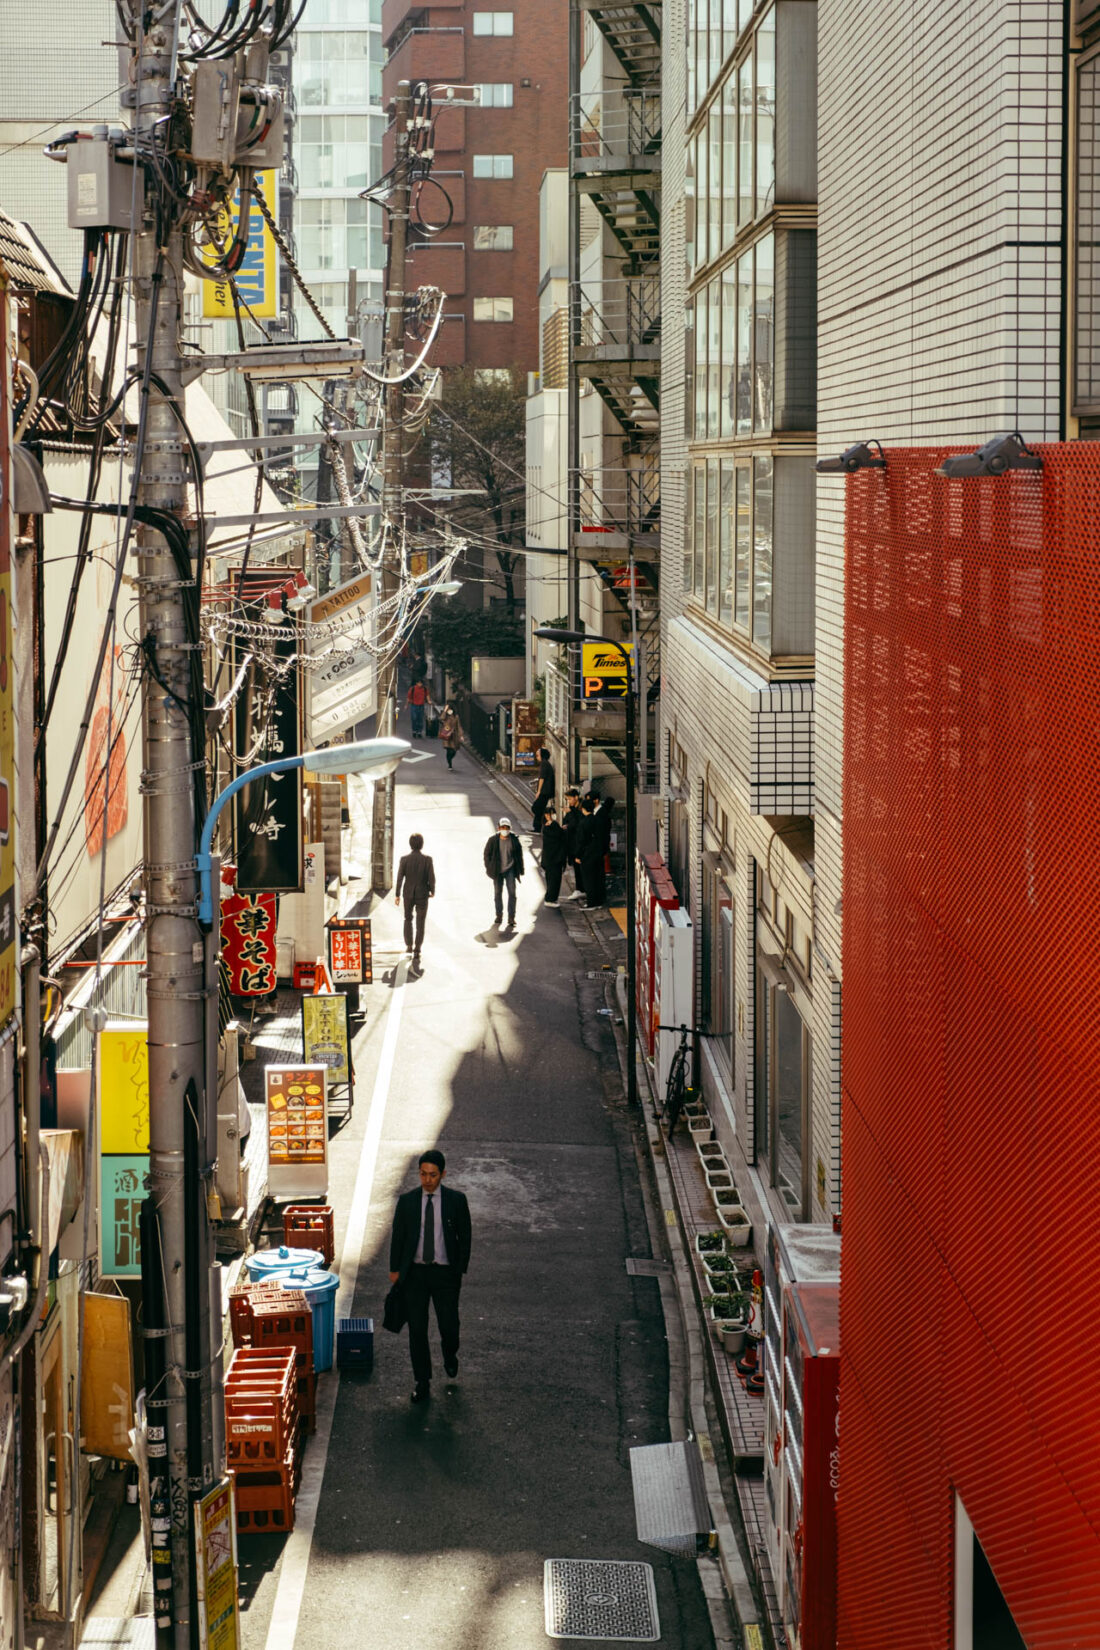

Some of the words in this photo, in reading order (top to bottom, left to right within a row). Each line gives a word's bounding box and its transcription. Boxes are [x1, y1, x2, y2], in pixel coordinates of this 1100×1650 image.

[328, 585, 361, 608] TATTOO
[593, 654, 627, 668] Times
[585, 677, 603, 697] P
[334, 932, 346, 968] もり中華
[348, 931, 359, 968] 中華そば
[319, 998, 331, 1041] TATTOO
